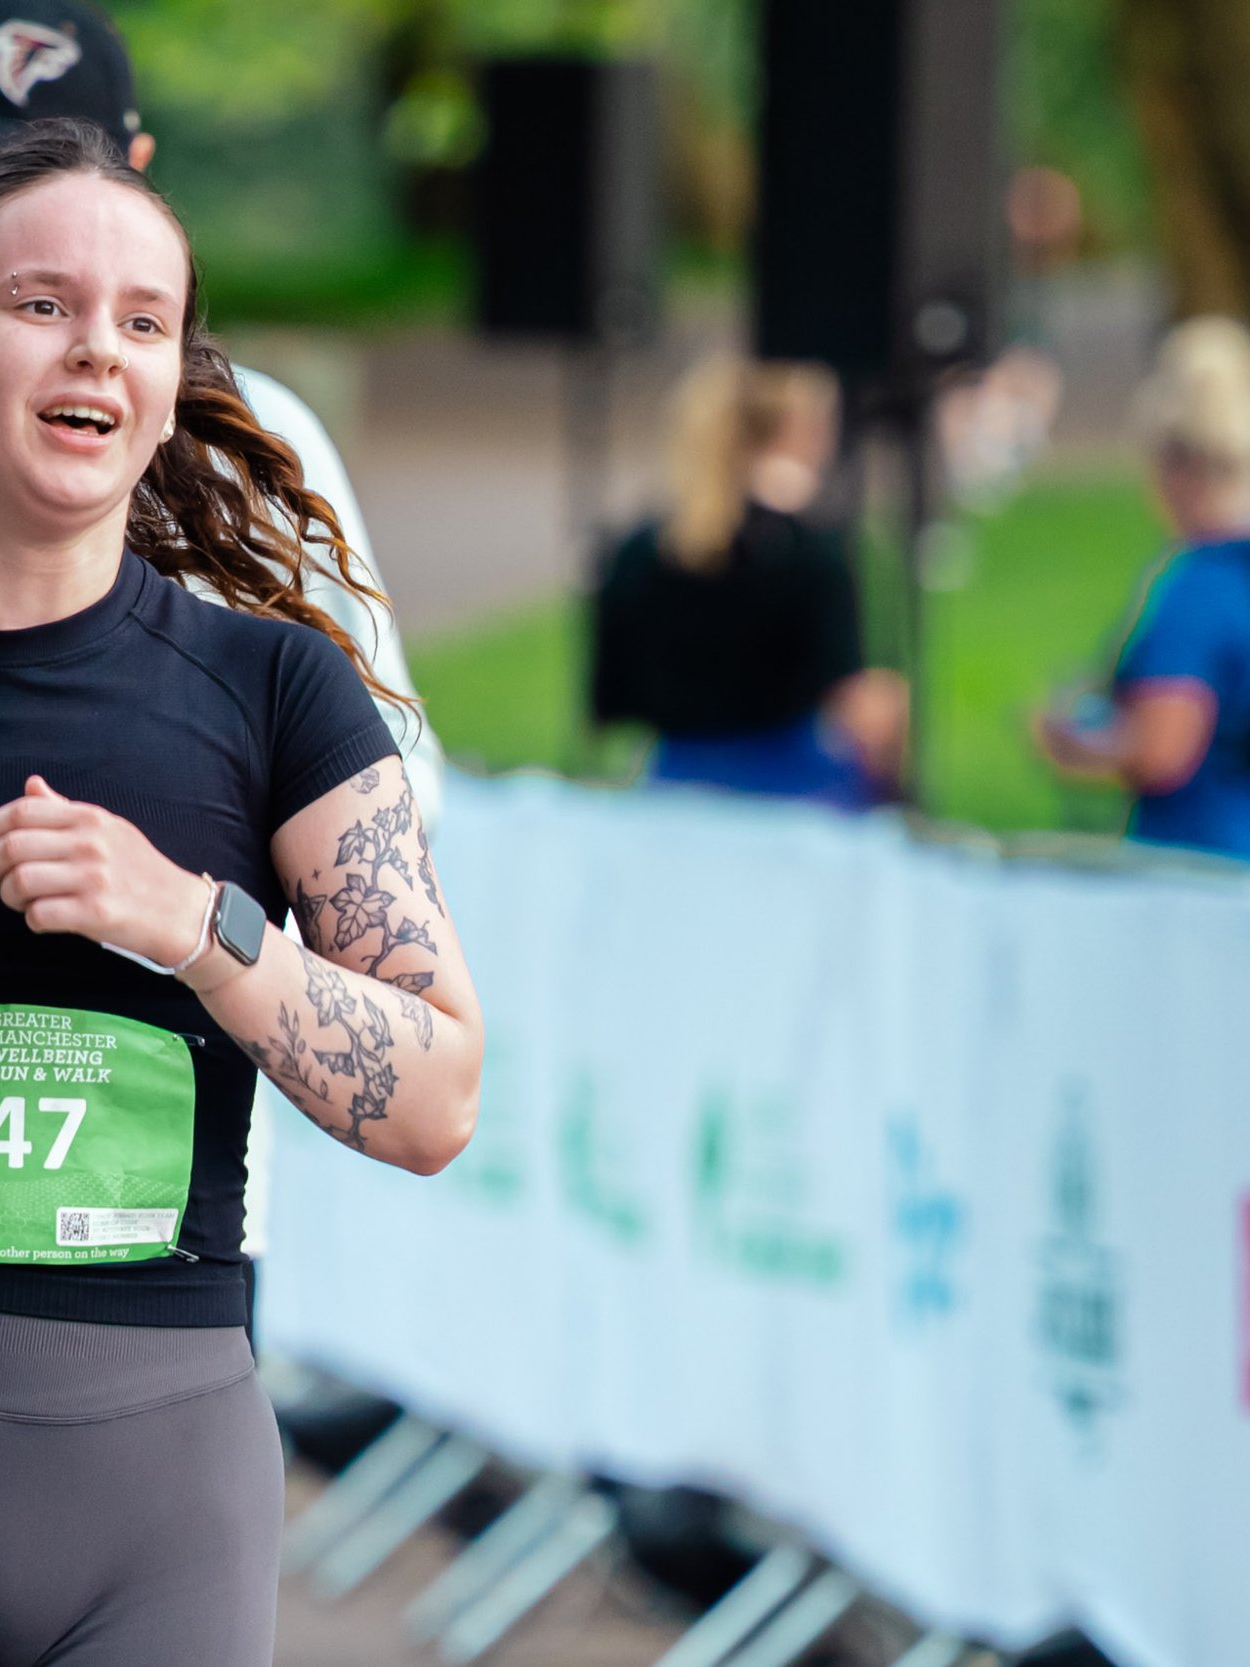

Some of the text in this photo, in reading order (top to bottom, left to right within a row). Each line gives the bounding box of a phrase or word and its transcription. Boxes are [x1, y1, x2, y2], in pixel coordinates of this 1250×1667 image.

[33, 1067, 47, 1082] &
[53, 1067, 112, 1083] WALK
[0, 1246, 30, 1259] other
[33, 1249, 72, 1261] person
[74, 1249, 88, 1259] on
[91, 1247, 107, 1258] the
[109, 1247, 130, 1258] way
